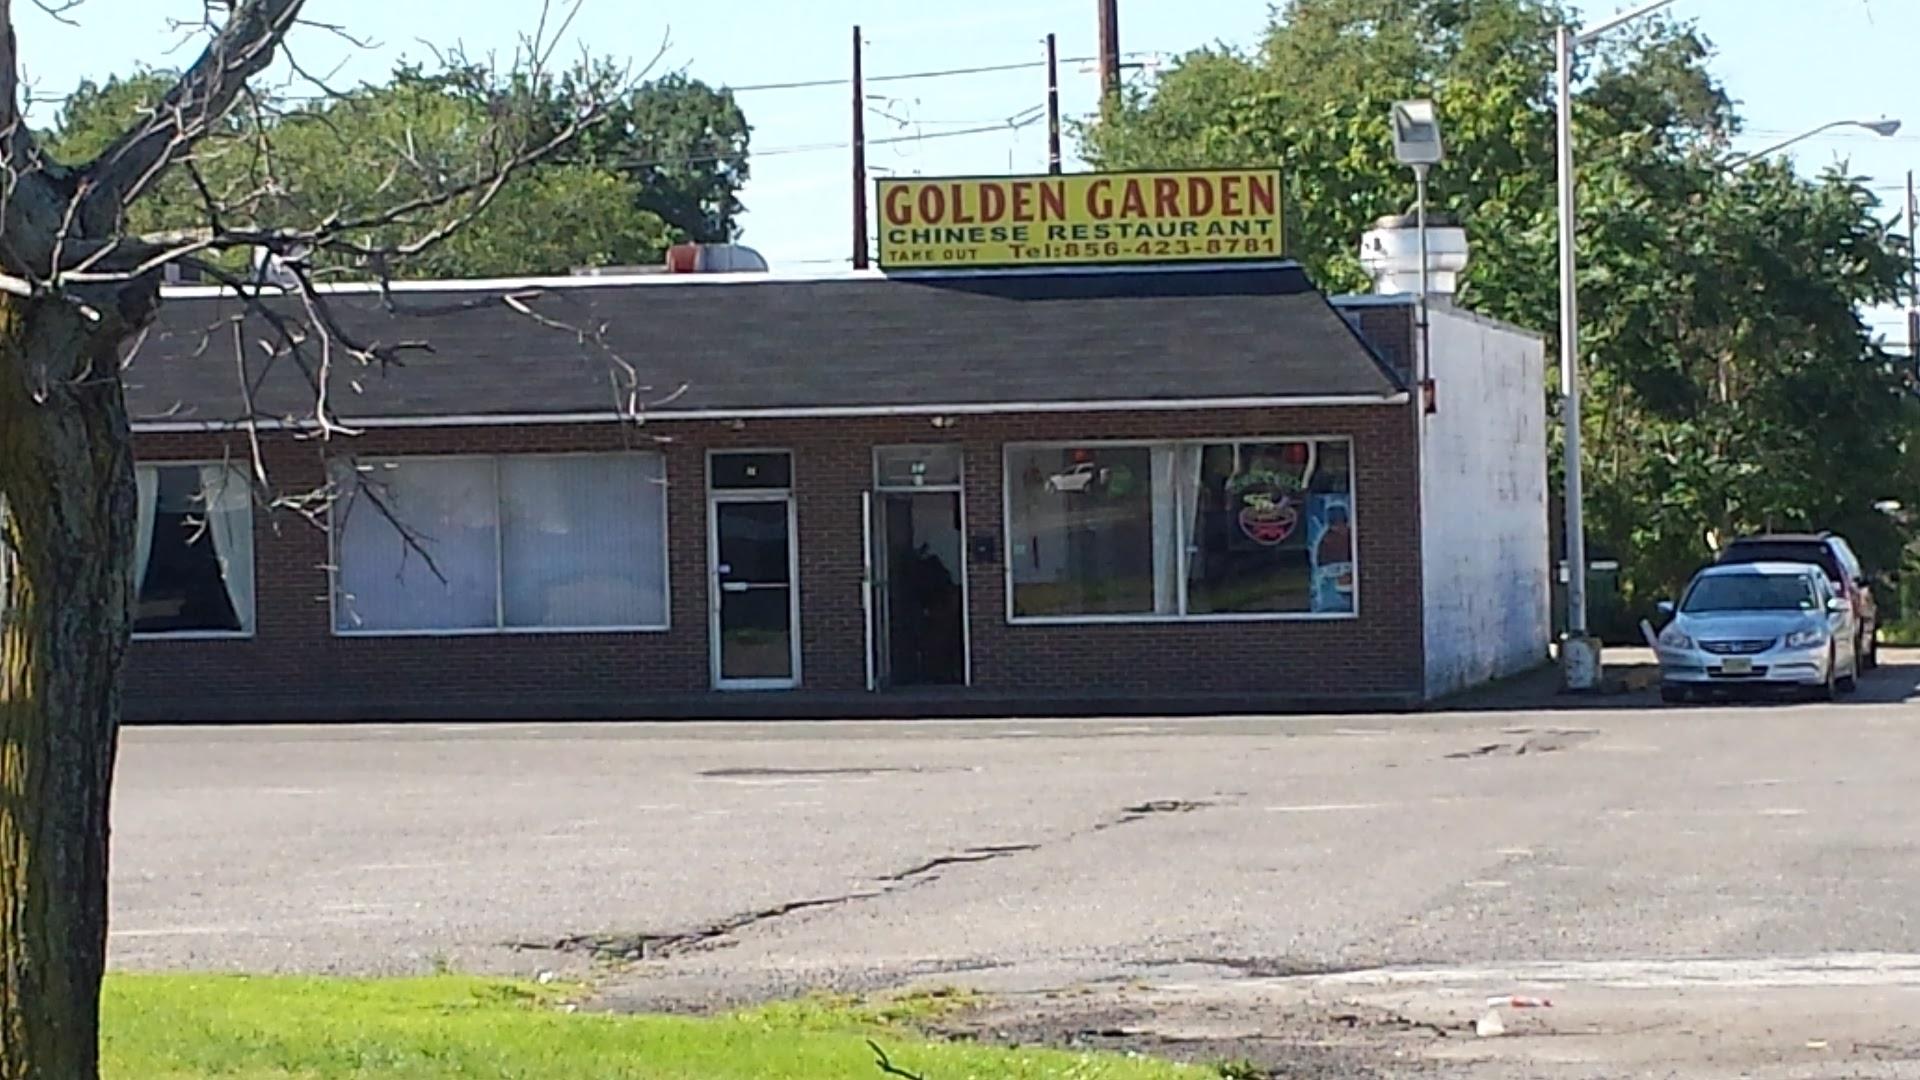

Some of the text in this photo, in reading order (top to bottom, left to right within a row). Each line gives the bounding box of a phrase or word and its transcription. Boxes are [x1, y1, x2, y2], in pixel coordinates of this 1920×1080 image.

[885, 175, 1275, 226] GOLDEN GARDEN
[888, 219, 1273, 244] CHINESE RESTAURANT
[889, 248, 977, 262] TAKE OUT
